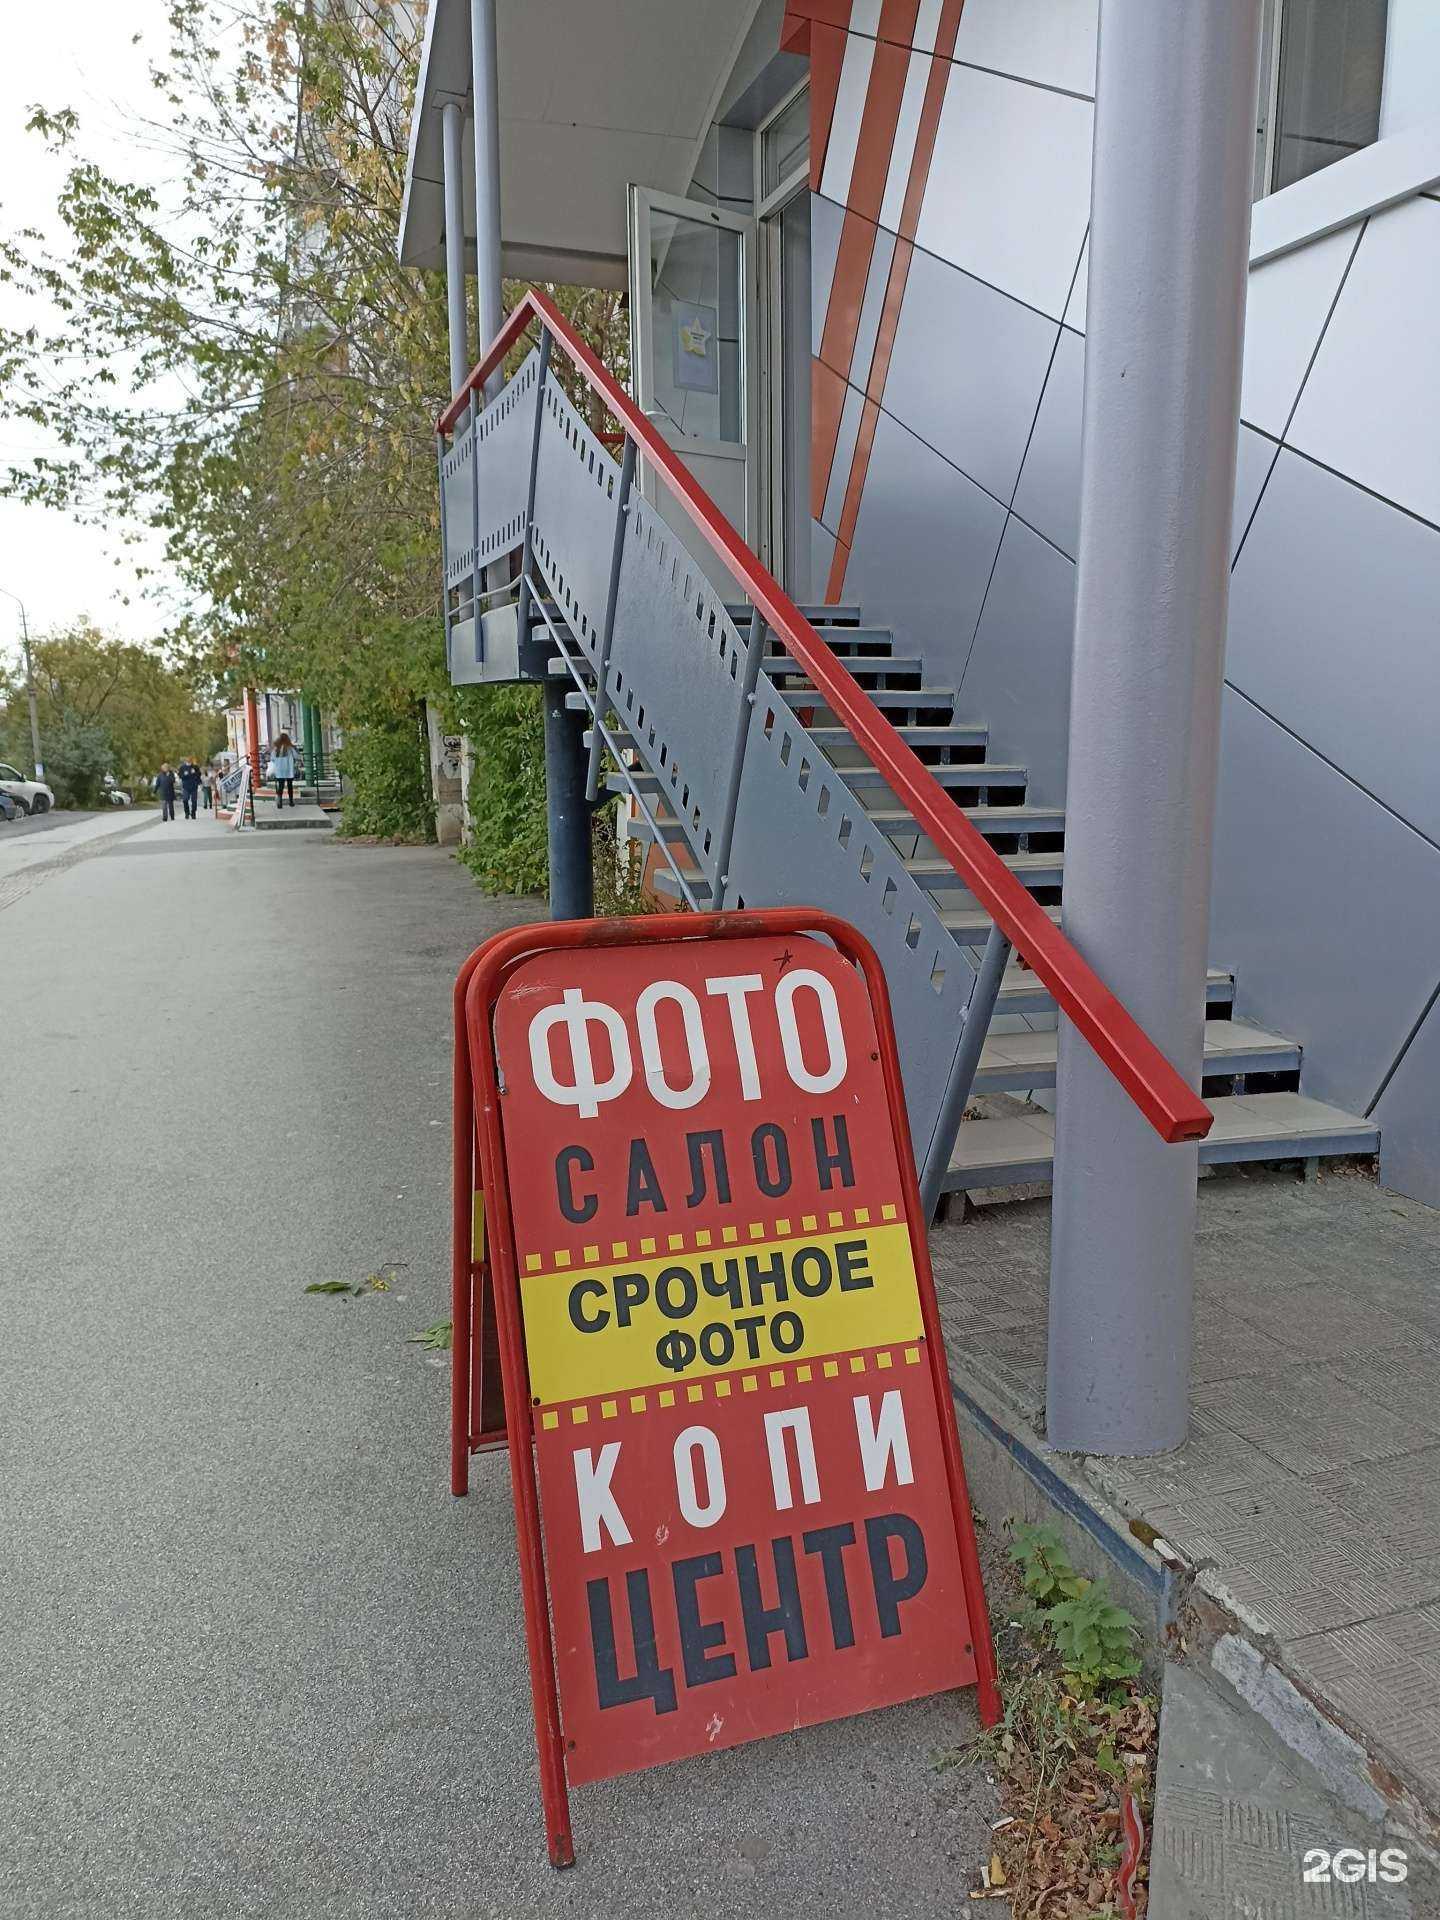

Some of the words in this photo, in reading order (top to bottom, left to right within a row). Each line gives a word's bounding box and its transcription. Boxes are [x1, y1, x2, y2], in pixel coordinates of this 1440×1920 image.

[528, 969, 848, 1119] ФОТО
[554, 1114, 856, 1224] САЛОН
[568, 1239, 874, 1334] СРОЧНОЕ
[655, 1311, 805, 1373] ФОТО
[573, 1390, 915, 1553] КОПИ
[586, 1512, 928, 1715] ЦЕНТР
